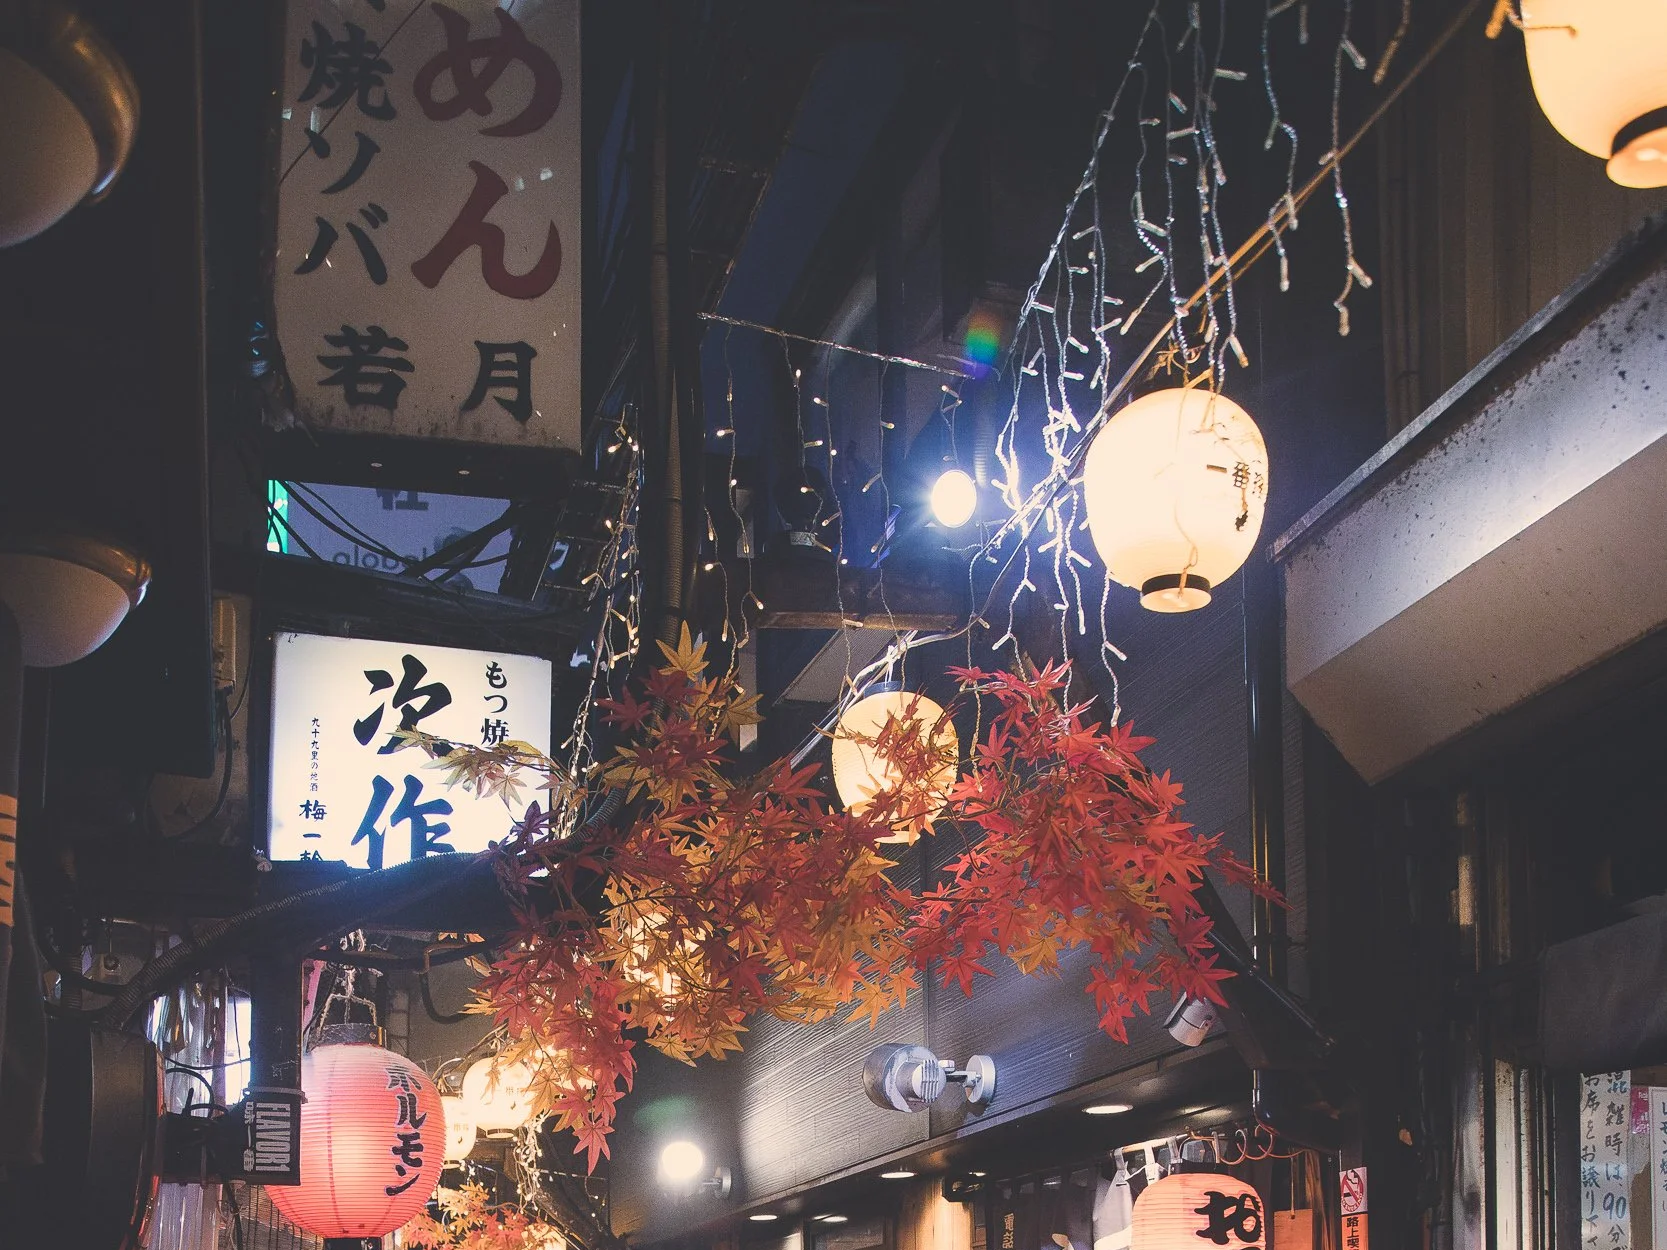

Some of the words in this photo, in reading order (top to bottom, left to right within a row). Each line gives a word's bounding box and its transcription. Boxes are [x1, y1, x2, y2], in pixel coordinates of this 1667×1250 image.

[411, 2, 563, 300] めん
[310, 717, 320, 792] 九十九里の地酒
[255, 1102, 291, 1172] FLAVOR1
[384, 1066, 428, 1198] ホルモン
